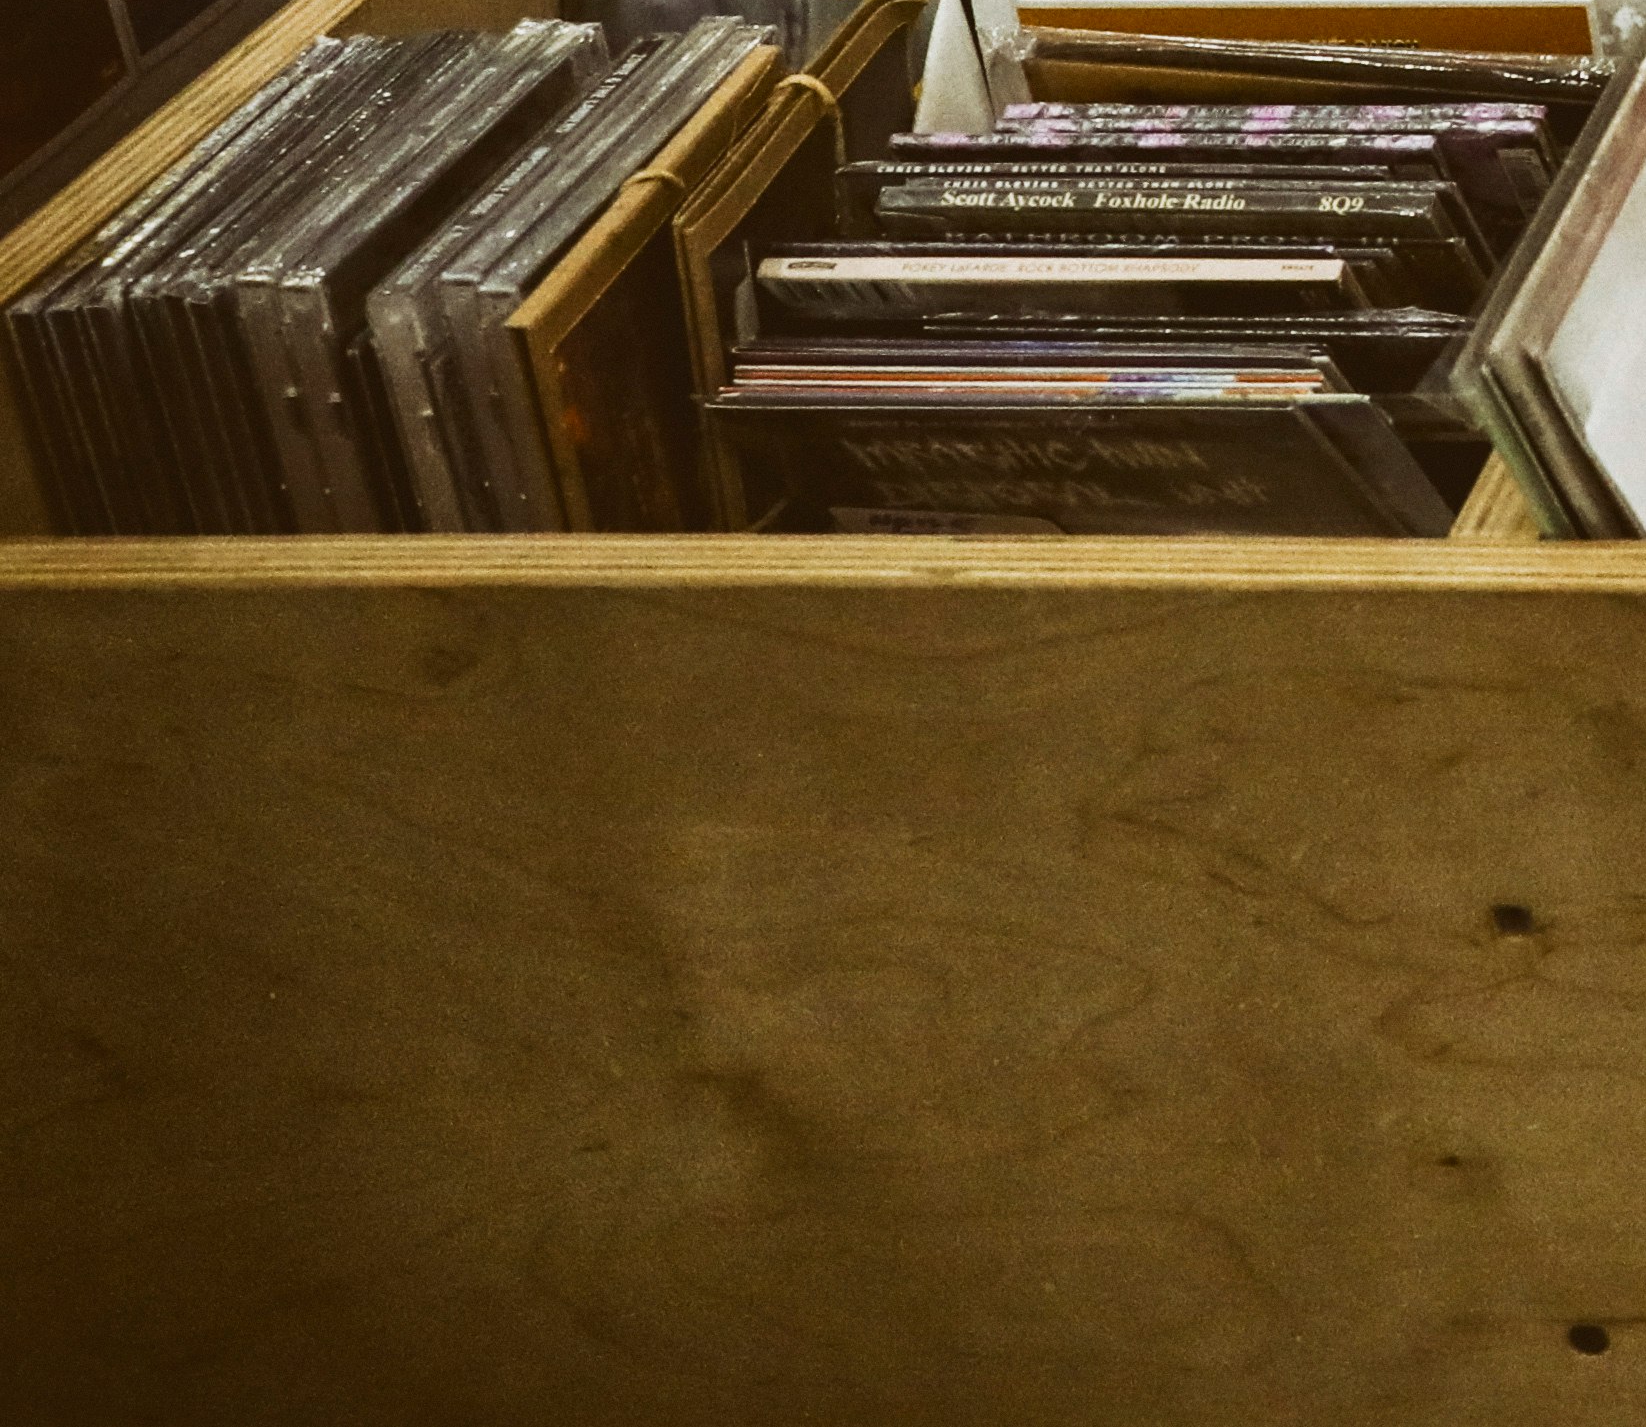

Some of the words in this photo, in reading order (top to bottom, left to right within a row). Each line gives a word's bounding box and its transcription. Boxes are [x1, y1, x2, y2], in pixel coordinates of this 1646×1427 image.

[940, 189, 997, 208] Scott
[999, 190, 1077, 210] Aycock
[1093, 193, 1179, 210] Foxhole
[1181, 194, 1247, 212] Radio
